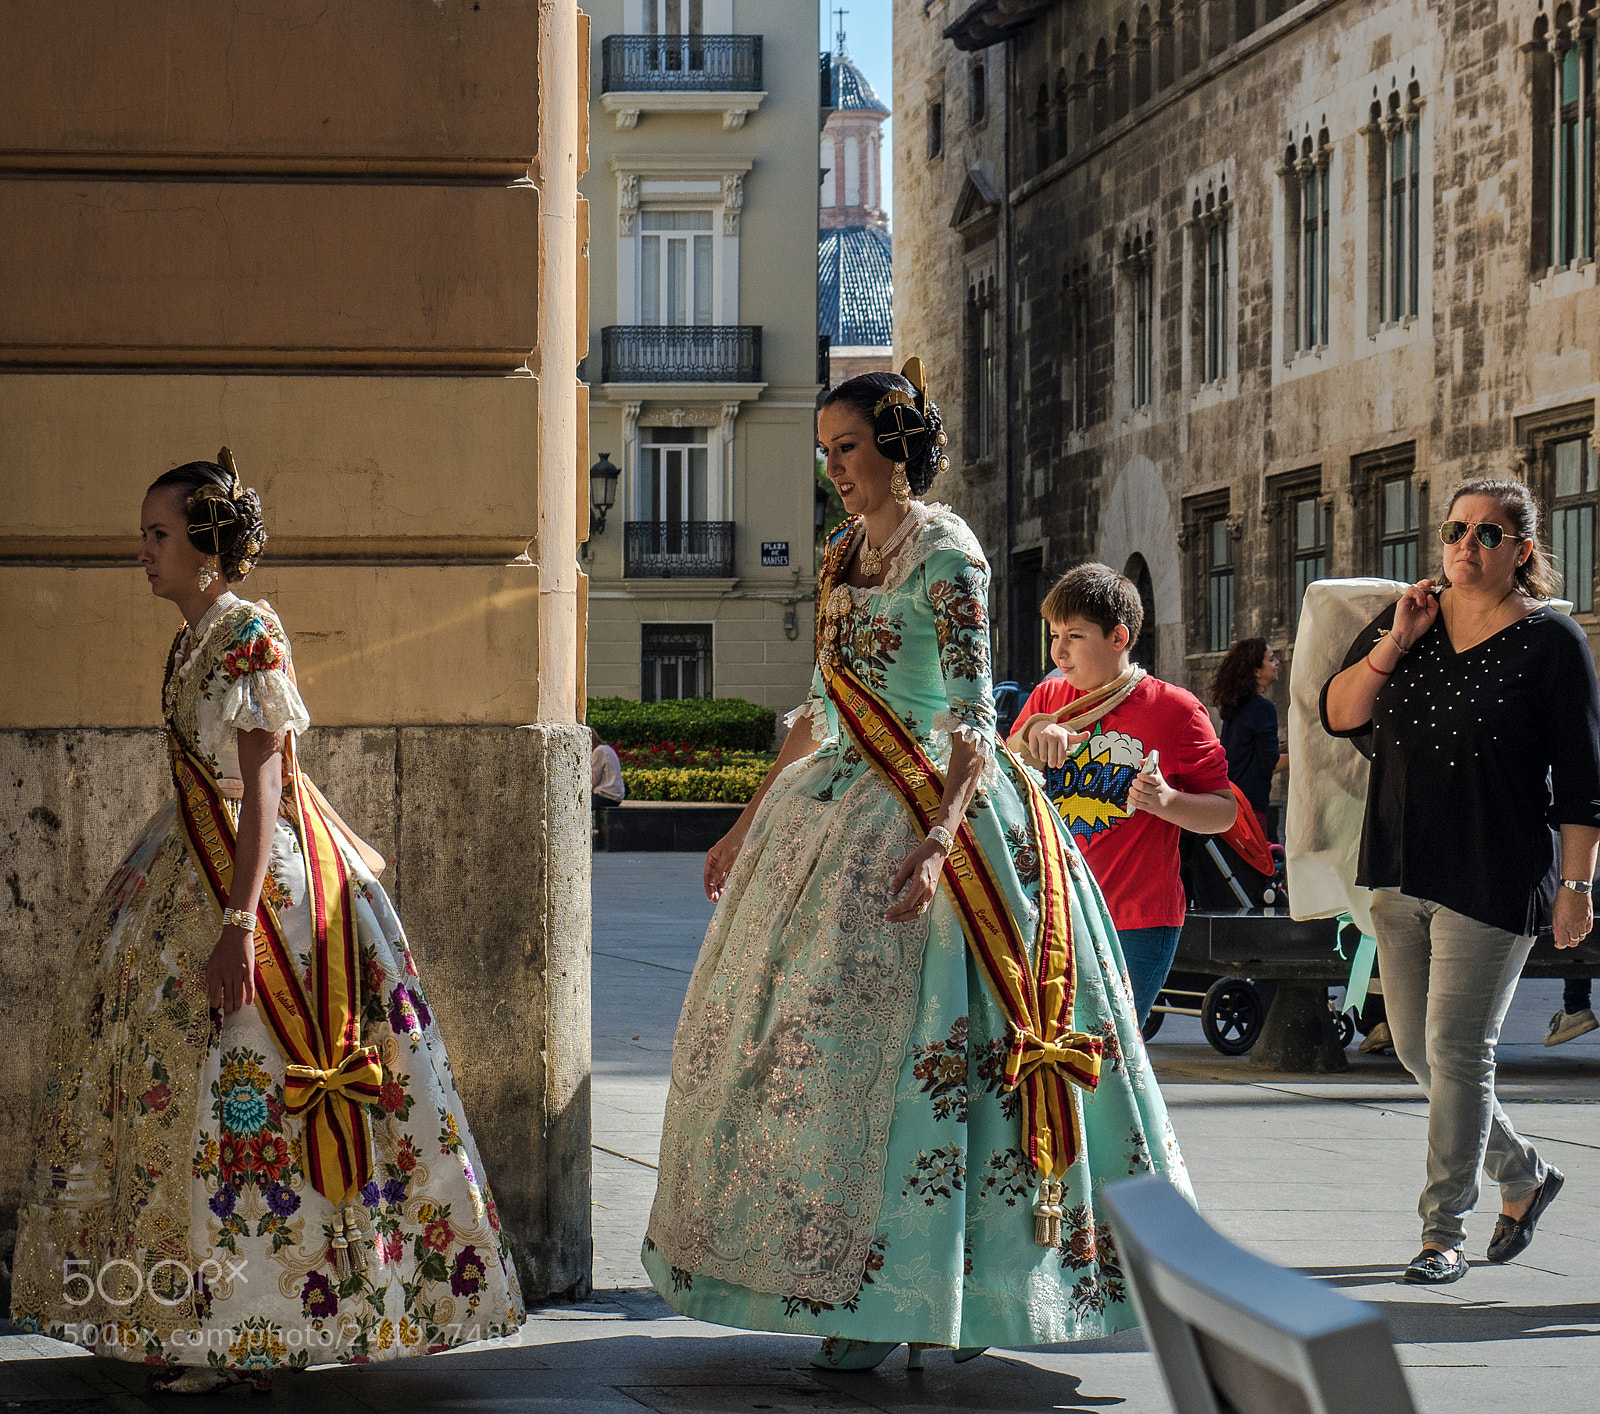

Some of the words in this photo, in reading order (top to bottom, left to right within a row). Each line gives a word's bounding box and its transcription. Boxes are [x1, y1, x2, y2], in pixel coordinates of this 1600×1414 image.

[762, 556, 788, 566] MANISES
[864, 714, 927, 793] Fallera
[187, 787, 231, 876] Fallera
[973, 908, 999, 936] Lorena
[272, 989, 297, 1017] Natalia
